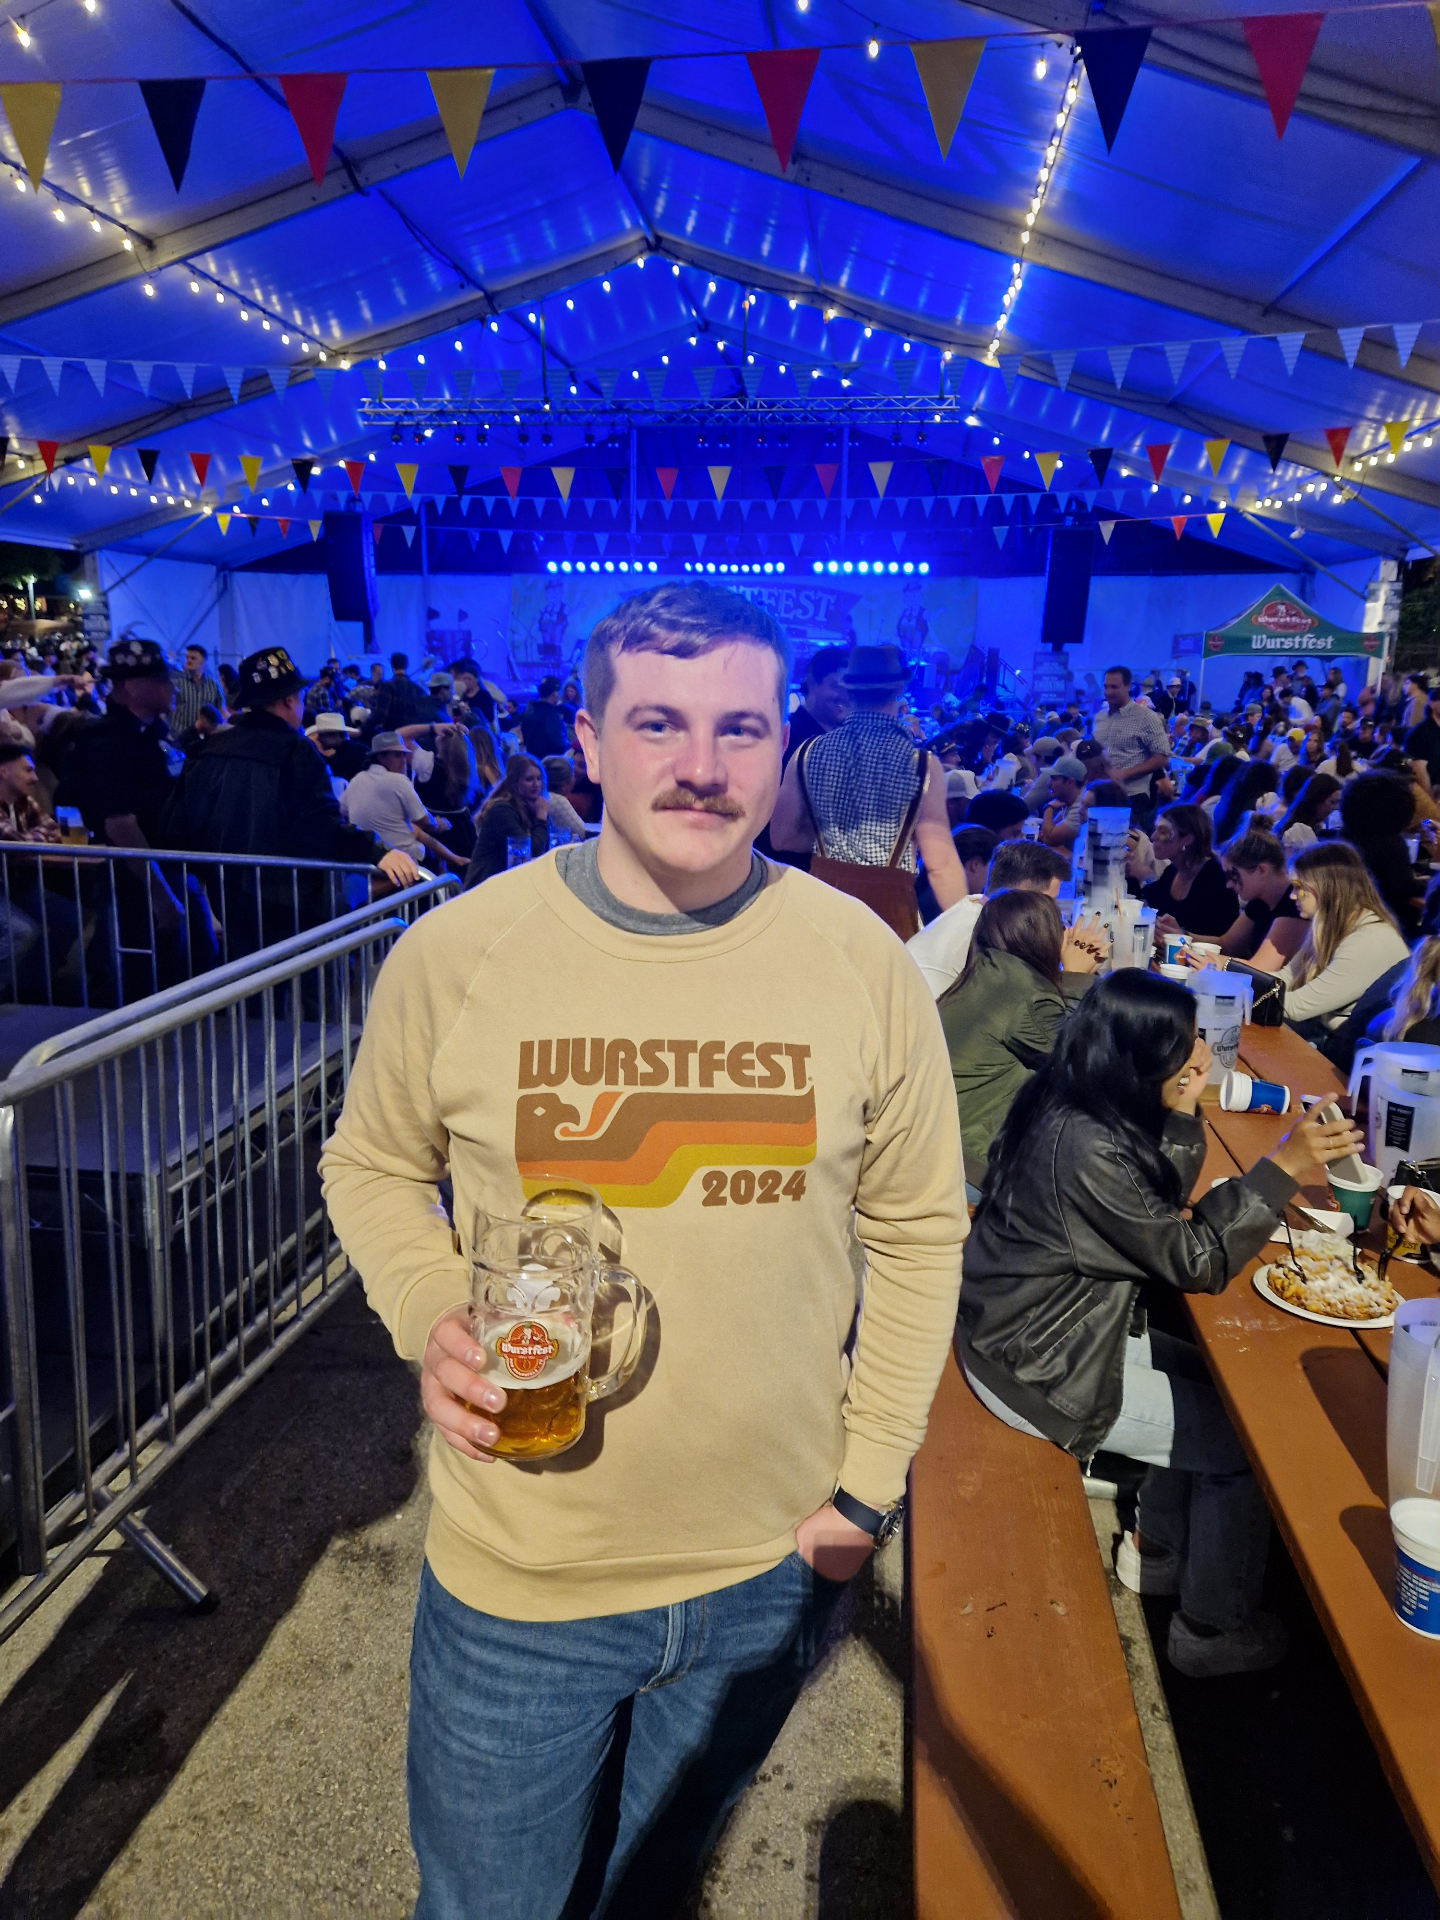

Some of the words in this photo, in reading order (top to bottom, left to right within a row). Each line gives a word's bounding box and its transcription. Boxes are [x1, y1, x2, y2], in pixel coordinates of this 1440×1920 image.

[727, 585, 838, 622] TFEST
[1251, 633, 1335, 650] Wurstfest
[517, 1037, 811, 1090] WURSTFEST
[701, 1169, 807, 1207] 2024
[501, 1342, 555, 1355] Wurstfest
